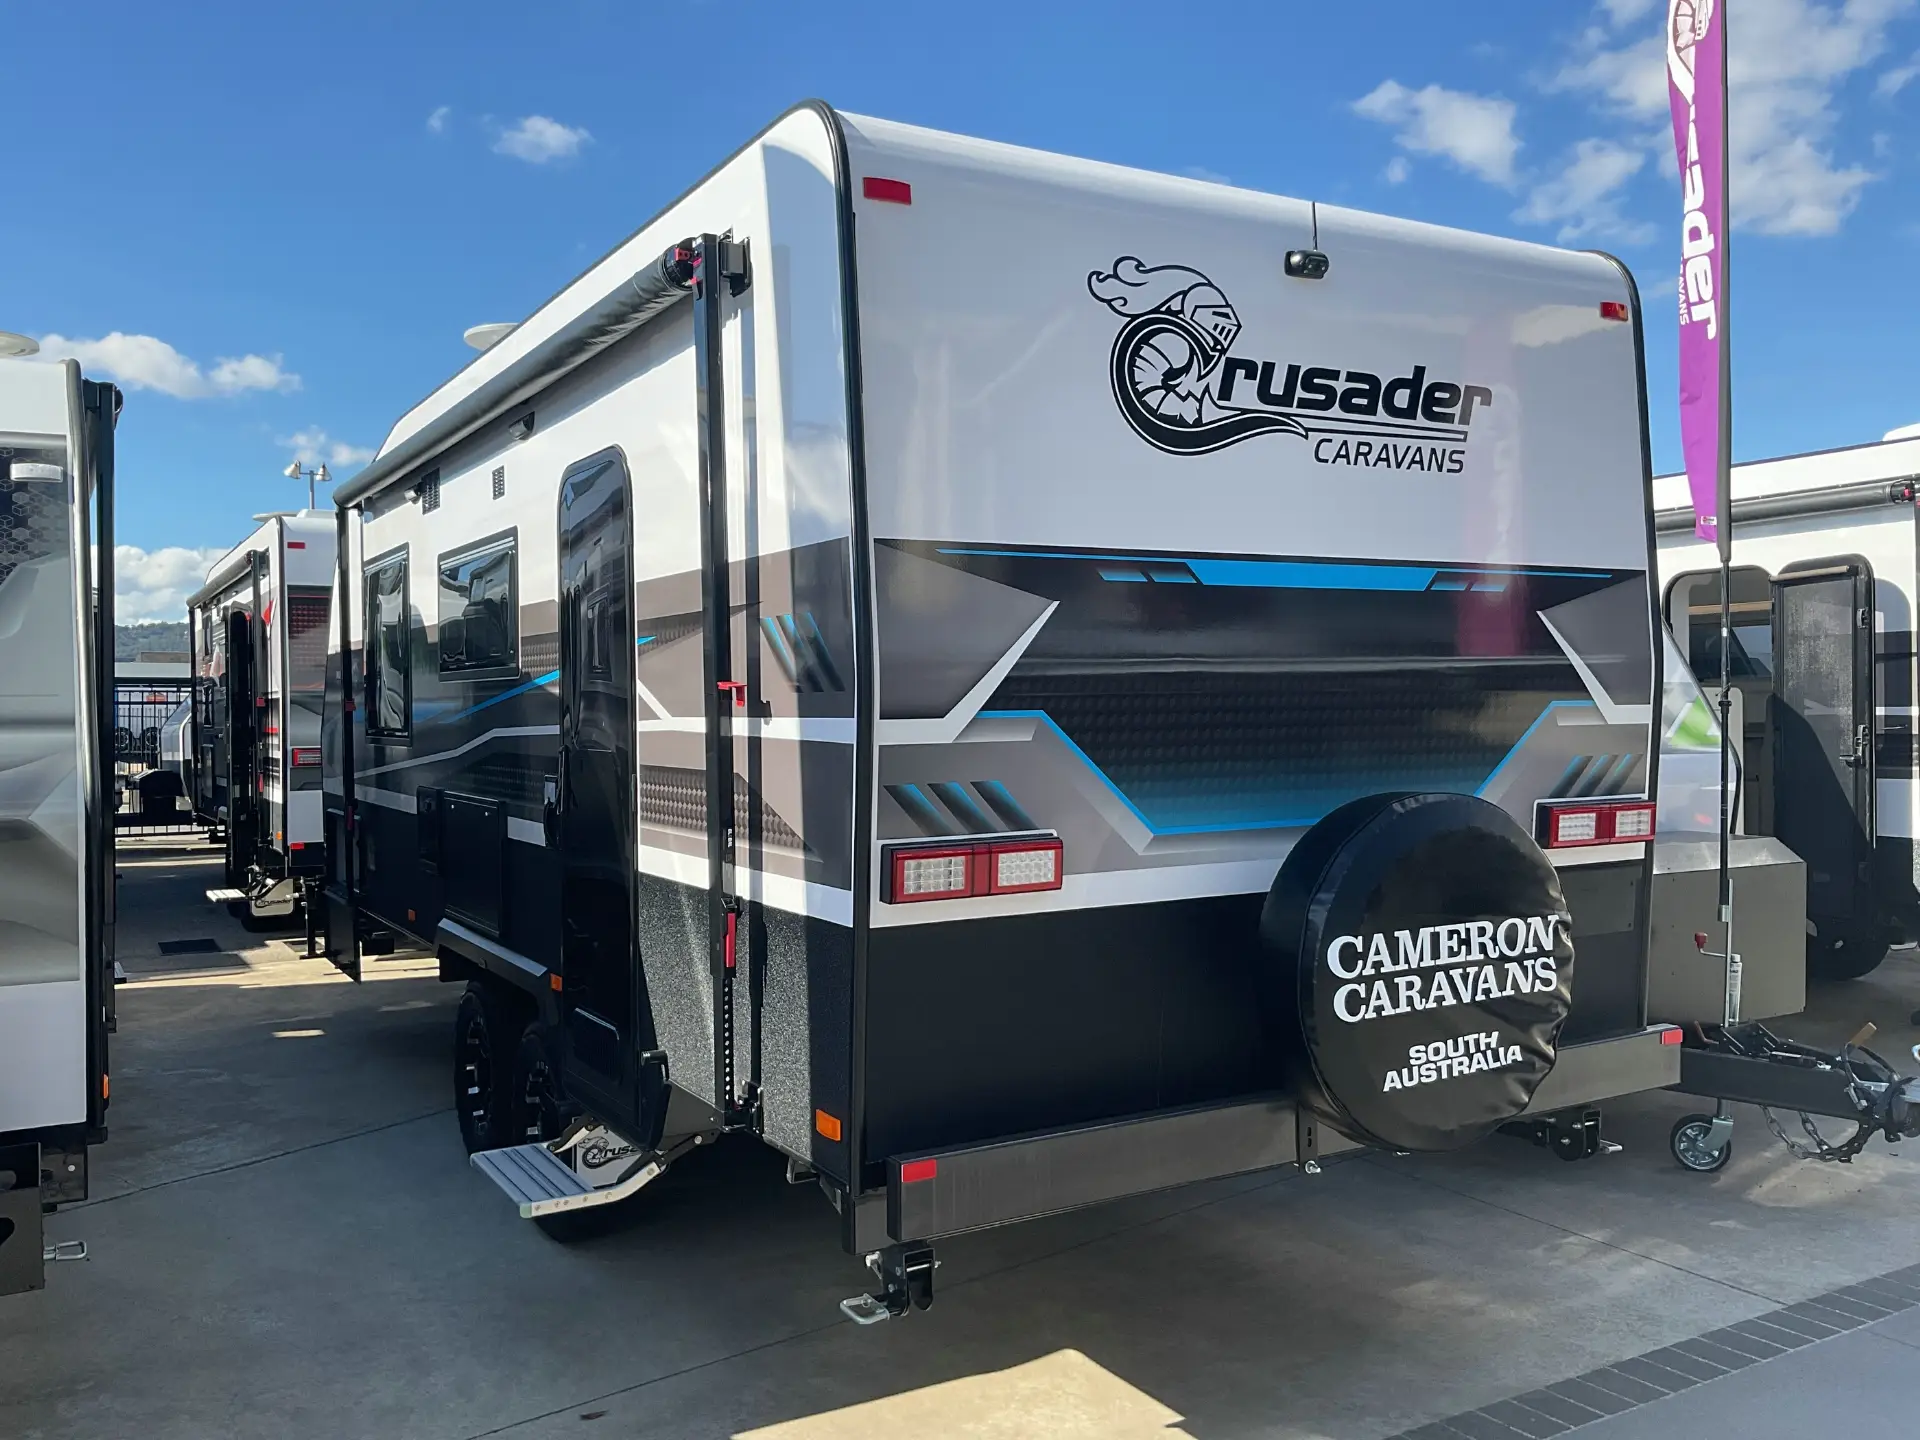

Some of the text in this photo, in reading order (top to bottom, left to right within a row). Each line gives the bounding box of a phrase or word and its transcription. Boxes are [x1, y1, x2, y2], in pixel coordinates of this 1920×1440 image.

[1110, 314, 1492, 456] Crusader
[1313, 438, 1466, 474] CARAVANS
[1327, 914, 1560, 979] CAMERON
[1333, 957, 1558, 1023] CARAVANS
[1383, 1045, 1523, 1092] AUSTRALIA
[1409, 1031, 1500, 1066] SOUTH
